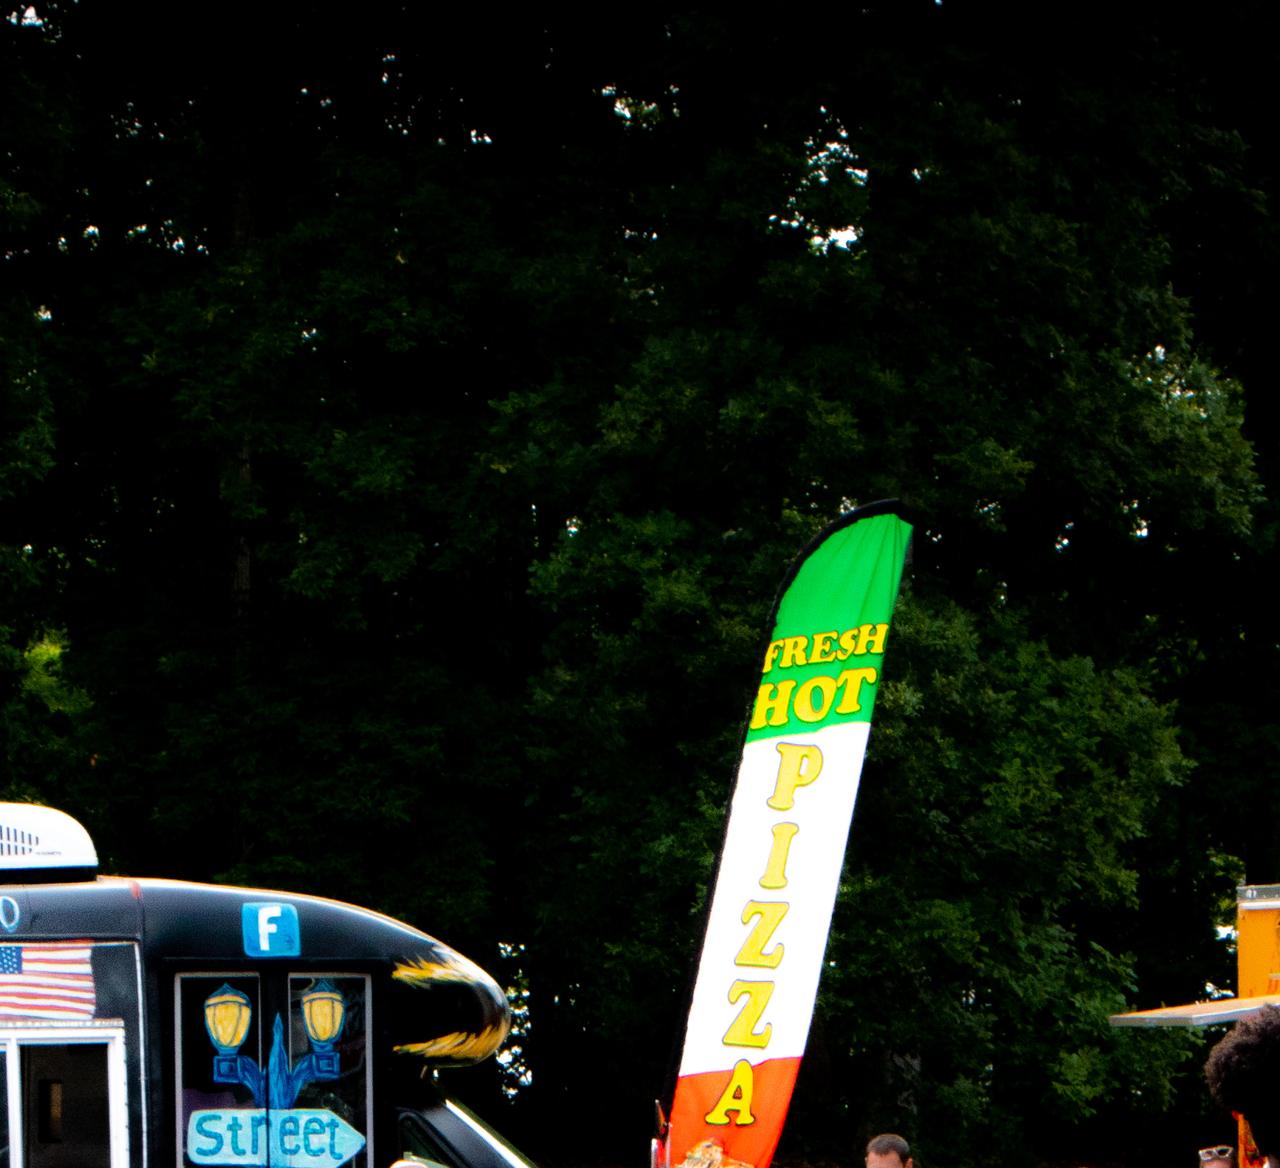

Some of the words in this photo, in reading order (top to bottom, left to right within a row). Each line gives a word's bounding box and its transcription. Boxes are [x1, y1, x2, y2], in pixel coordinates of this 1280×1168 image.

[762, 623, 889, 673] FRESH
[750, 667, 877, 730] HOT
[705, 742, 824, 1127] PIZZA
[196, 1113, 344, 1160] Street
